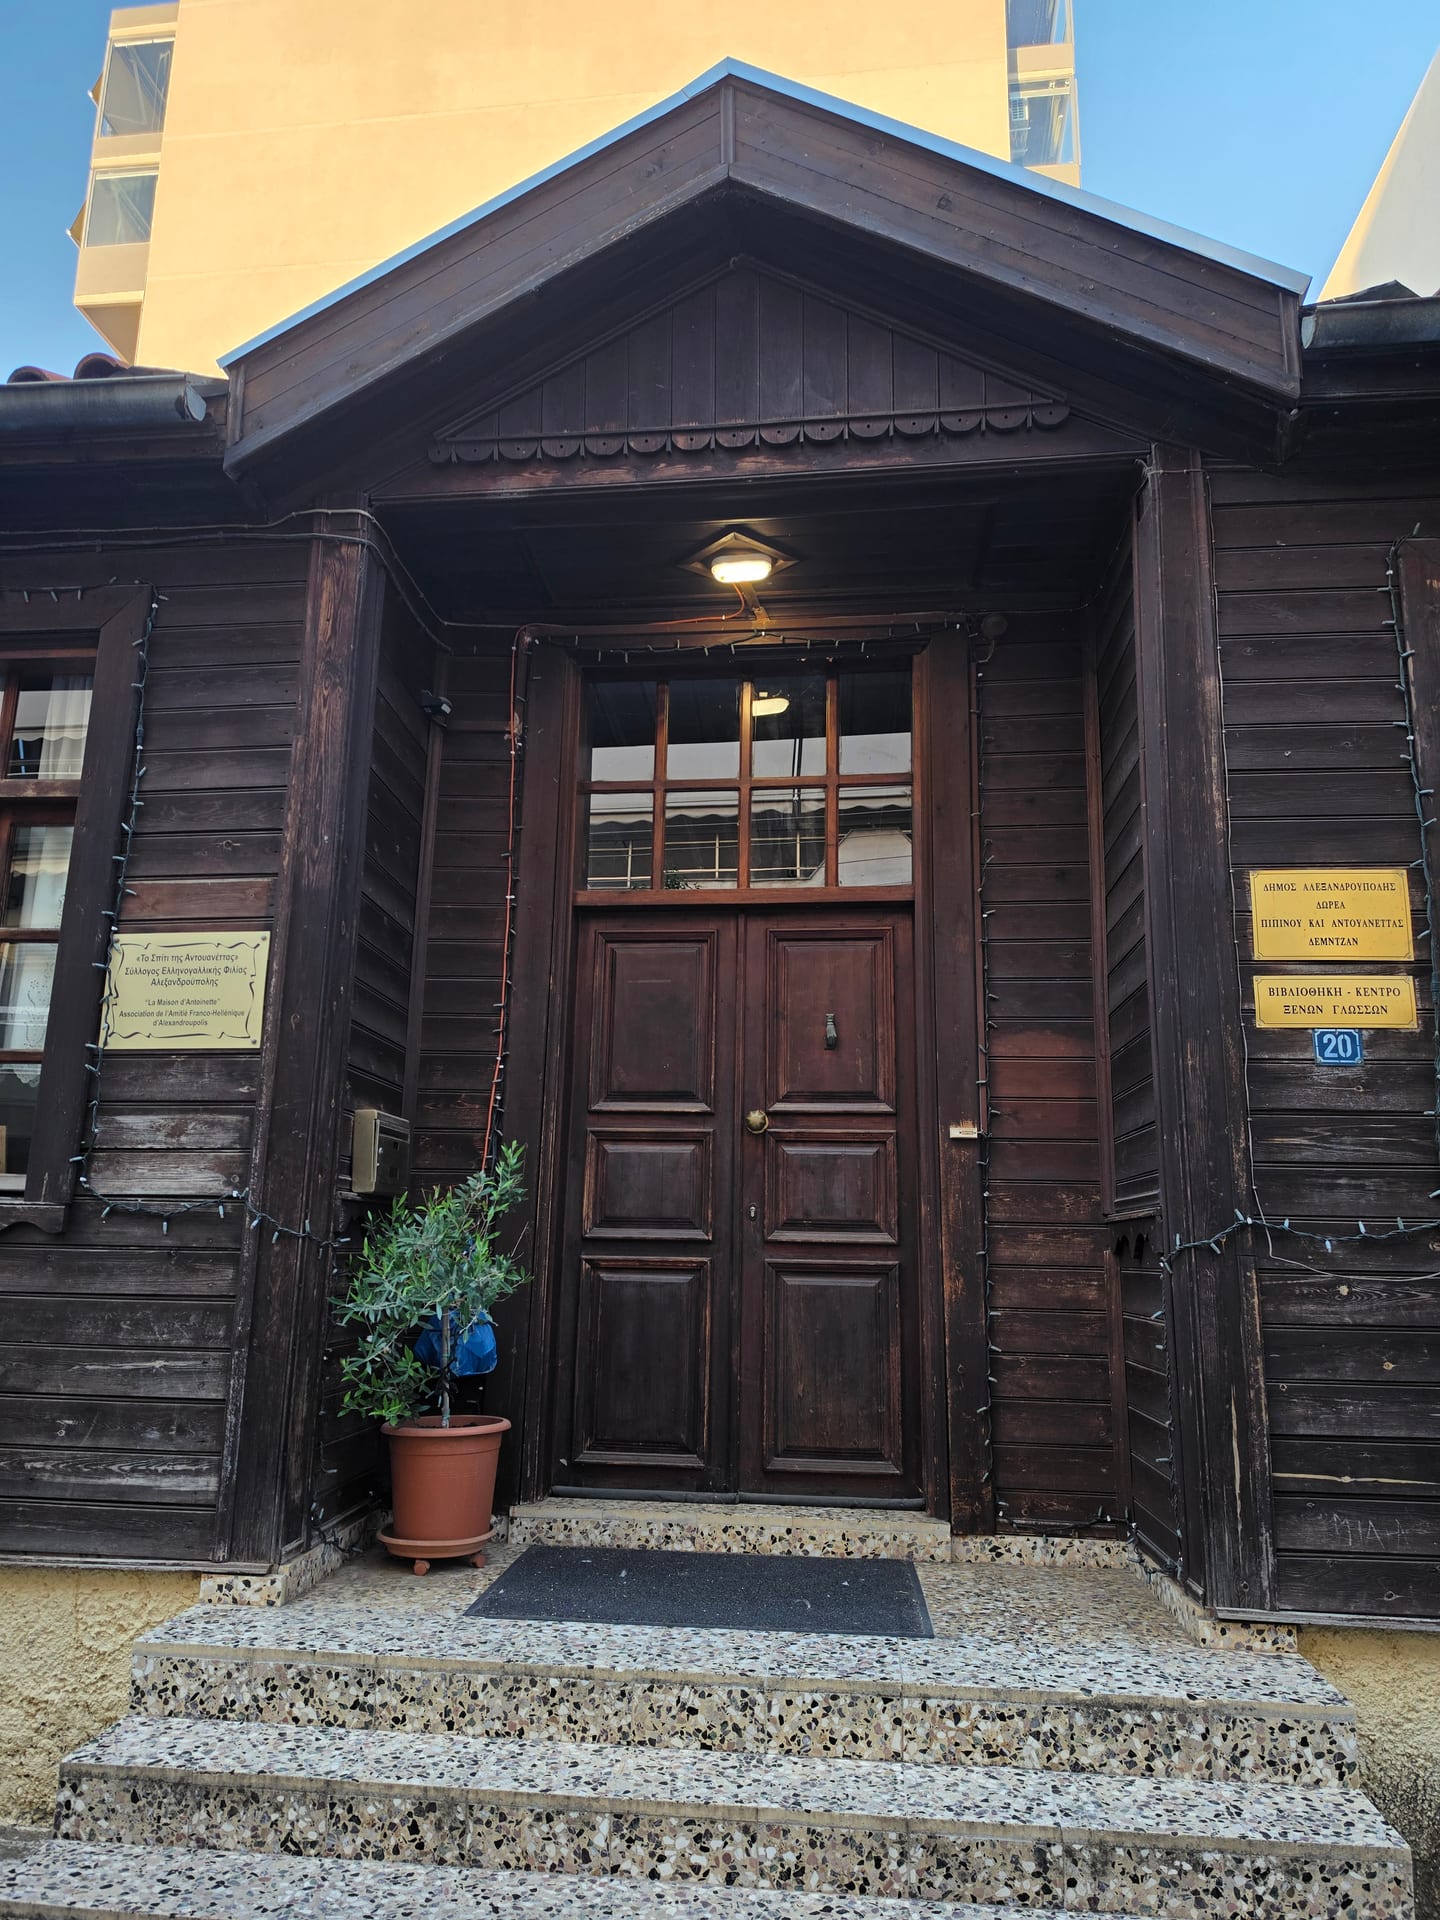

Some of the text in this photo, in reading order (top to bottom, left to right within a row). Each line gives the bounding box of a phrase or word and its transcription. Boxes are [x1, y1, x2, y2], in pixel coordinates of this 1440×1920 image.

[1263, 882, 1397, 892] ΔΗΜΟΣ ΑΛΕΞΑΝΔΡΟΥΠΟΛΗΣ
[1316, 901, 1346, 910] ΔΩΡΕΑ
[1261, 918, 1404, 928] ΠΙΠΙΝΟΥ ΚΑΙ ΑΝΤΟΥΑΝΕΤΤΑΣ
[1308, 937, 1359, 946] ΔΕΜΝΤΖΑΝ
[171, 954, 183, 963] της
[1268, 987, 1343, 997] ΒΙΒΛΙΟΘΗΚΗ
[1355, 987, 1401, 997] ΚΕΝΤΡΟ
[1283, 1005, 1388, 1014] ΞΕΝΩΝ ΓΛΩΣΣΩΝ
[1322, 1033, 1353, 1058] 20
